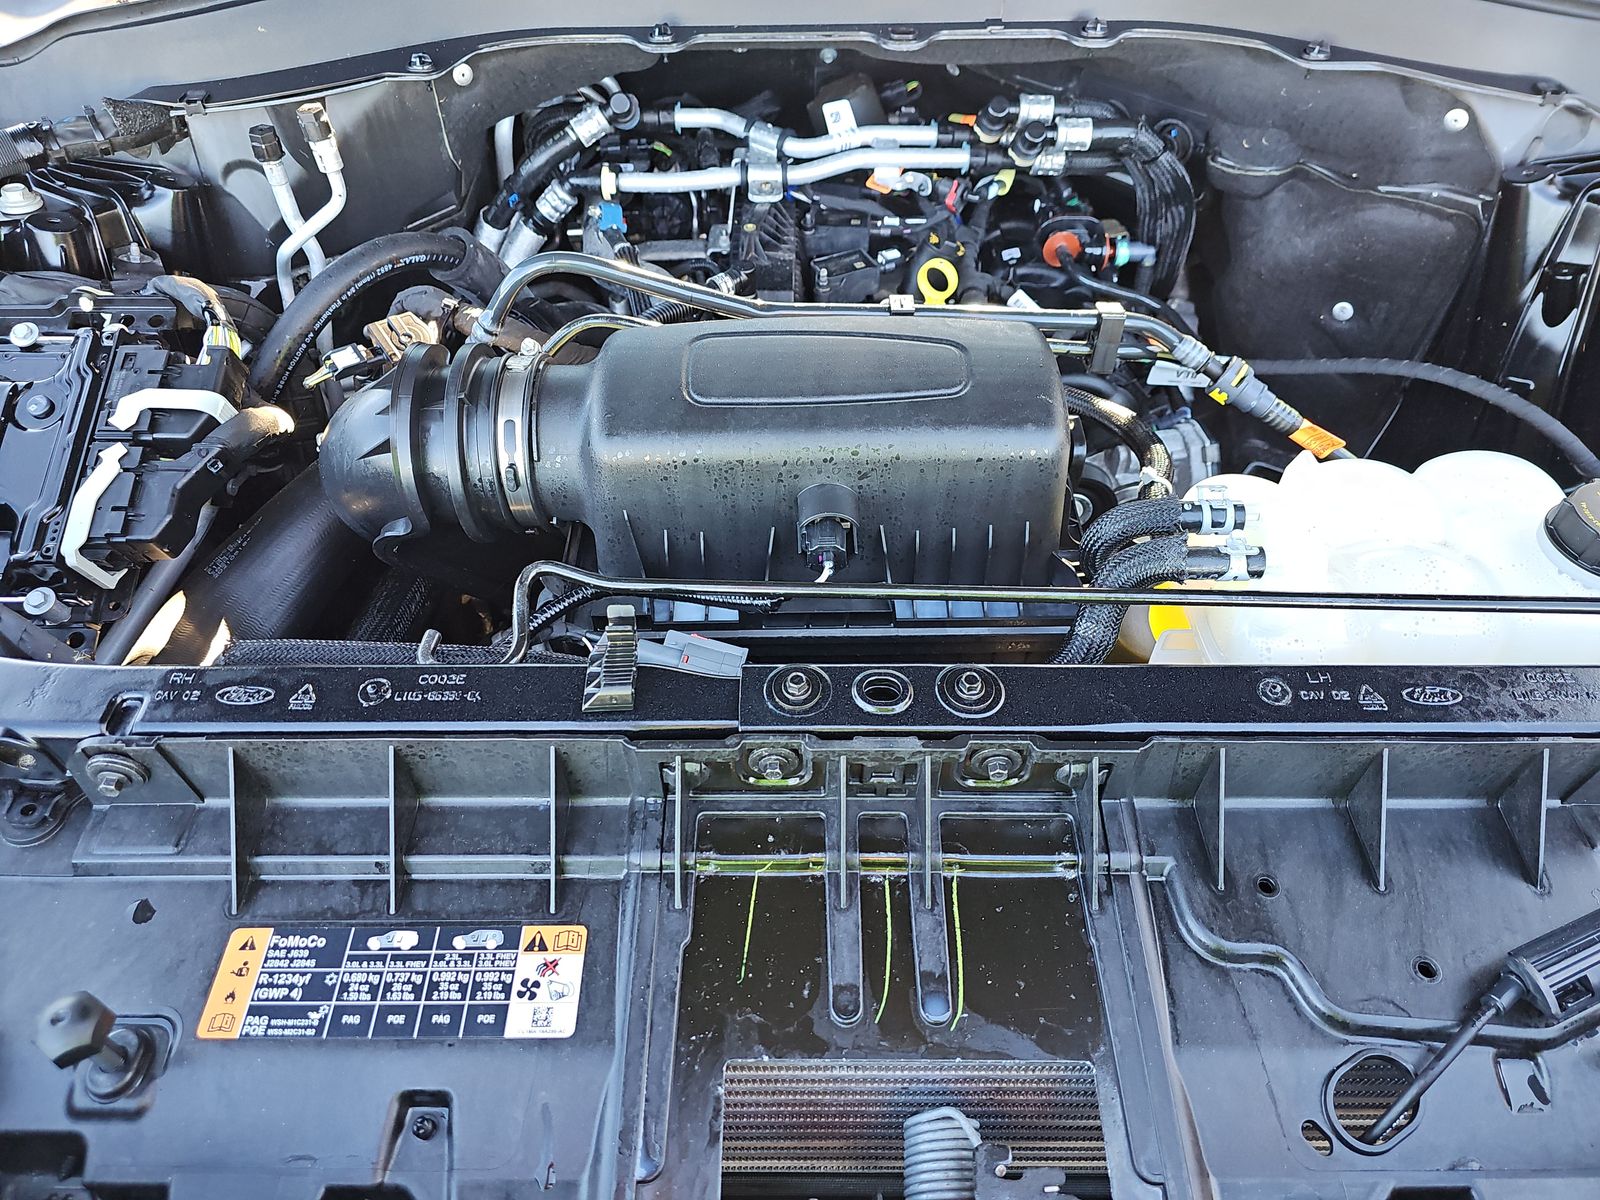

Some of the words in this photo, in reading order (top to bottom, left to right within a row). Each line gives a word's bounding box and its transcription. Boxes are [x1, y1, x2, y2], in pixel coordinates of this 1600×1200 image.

[287, 343, 307, 371] SUCTION
[277, 371, 291, 389] HOSE
[169, 672, 195, 684] RH
[1305, 672, 1332, 683] LH
[219, 686, 270, 704] Ford
[1408, 687, 1457, 703] Ford
[270, 935, 326, 948] FoMoCo
[267, 949, 288, 958] SAE
[287, 949, 309, 958] J639
[258, 973, 312, 987] R-1234yf
[368, 972, 380, 985] kg
[386, 972, 410, 983] 0.737
[410, 972, 423, 985] kg
[432, 971, 457, 982] 0.992
[457, 971, 470, 984] kg
[475, 972, 499, 982] 0.992
[500, 972, 512, 984] kg
[348, 983, 359, 991] 24
[438, 982, 449, 991] 35
[481, 982, 492, 991] 35
[253, 987, 289, 1001] (GWP
[289, 987, 303, 1001] 4)
[360, 992, 371, 1000] lbs
[403, 992, 415, 1000] lbs
[432, 991, 448, 1000] 2.19
[449, 991, 462, 1000] lbs
[475, 991, 492, 1000] 2.19
[493, 991, 506, 1000] lbs
[245, 1015, 269, 1025] PAG
[341, 1014, 361, 1024] PAG
[386, 1014, 406, 1024] POE
[431, 1014, 451, 1024] PAG
[476, 1014, 496, 1024] POE
[241, 1025, 267, 1035] POE
